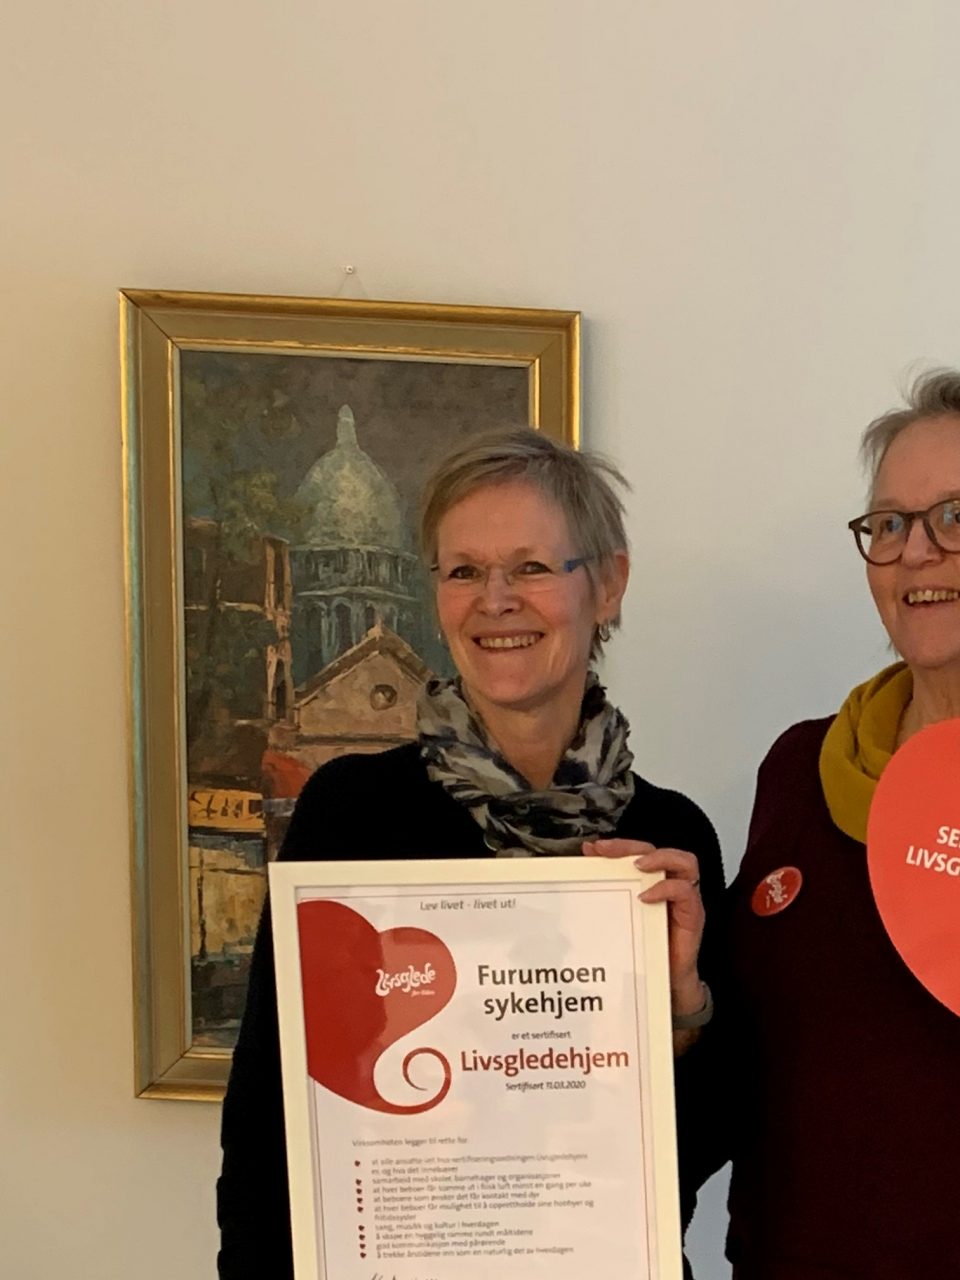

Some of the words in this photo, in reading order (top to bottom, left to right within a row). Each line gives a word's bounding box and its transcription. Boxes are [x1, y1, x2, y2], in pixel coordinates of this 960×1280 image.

[420, 901, 438, 911] Lev
[440, 900, 464, 910] livet
[473, 899, 497, 909] livet
[500, 898, 517, 909] ut!
[375, 962, 436, 997] Livsglede
[478, 964, 606, 986] Furumoen
[484, 990, 603, 1020] sykehjem
[521, 1032, 530, 1040] et
[531, 1030, 572, 1039] sertifisert
[461, 1046, 629, 1077] Livsgledehjem
[506, 1081, 544, 1092] Sertifisert
